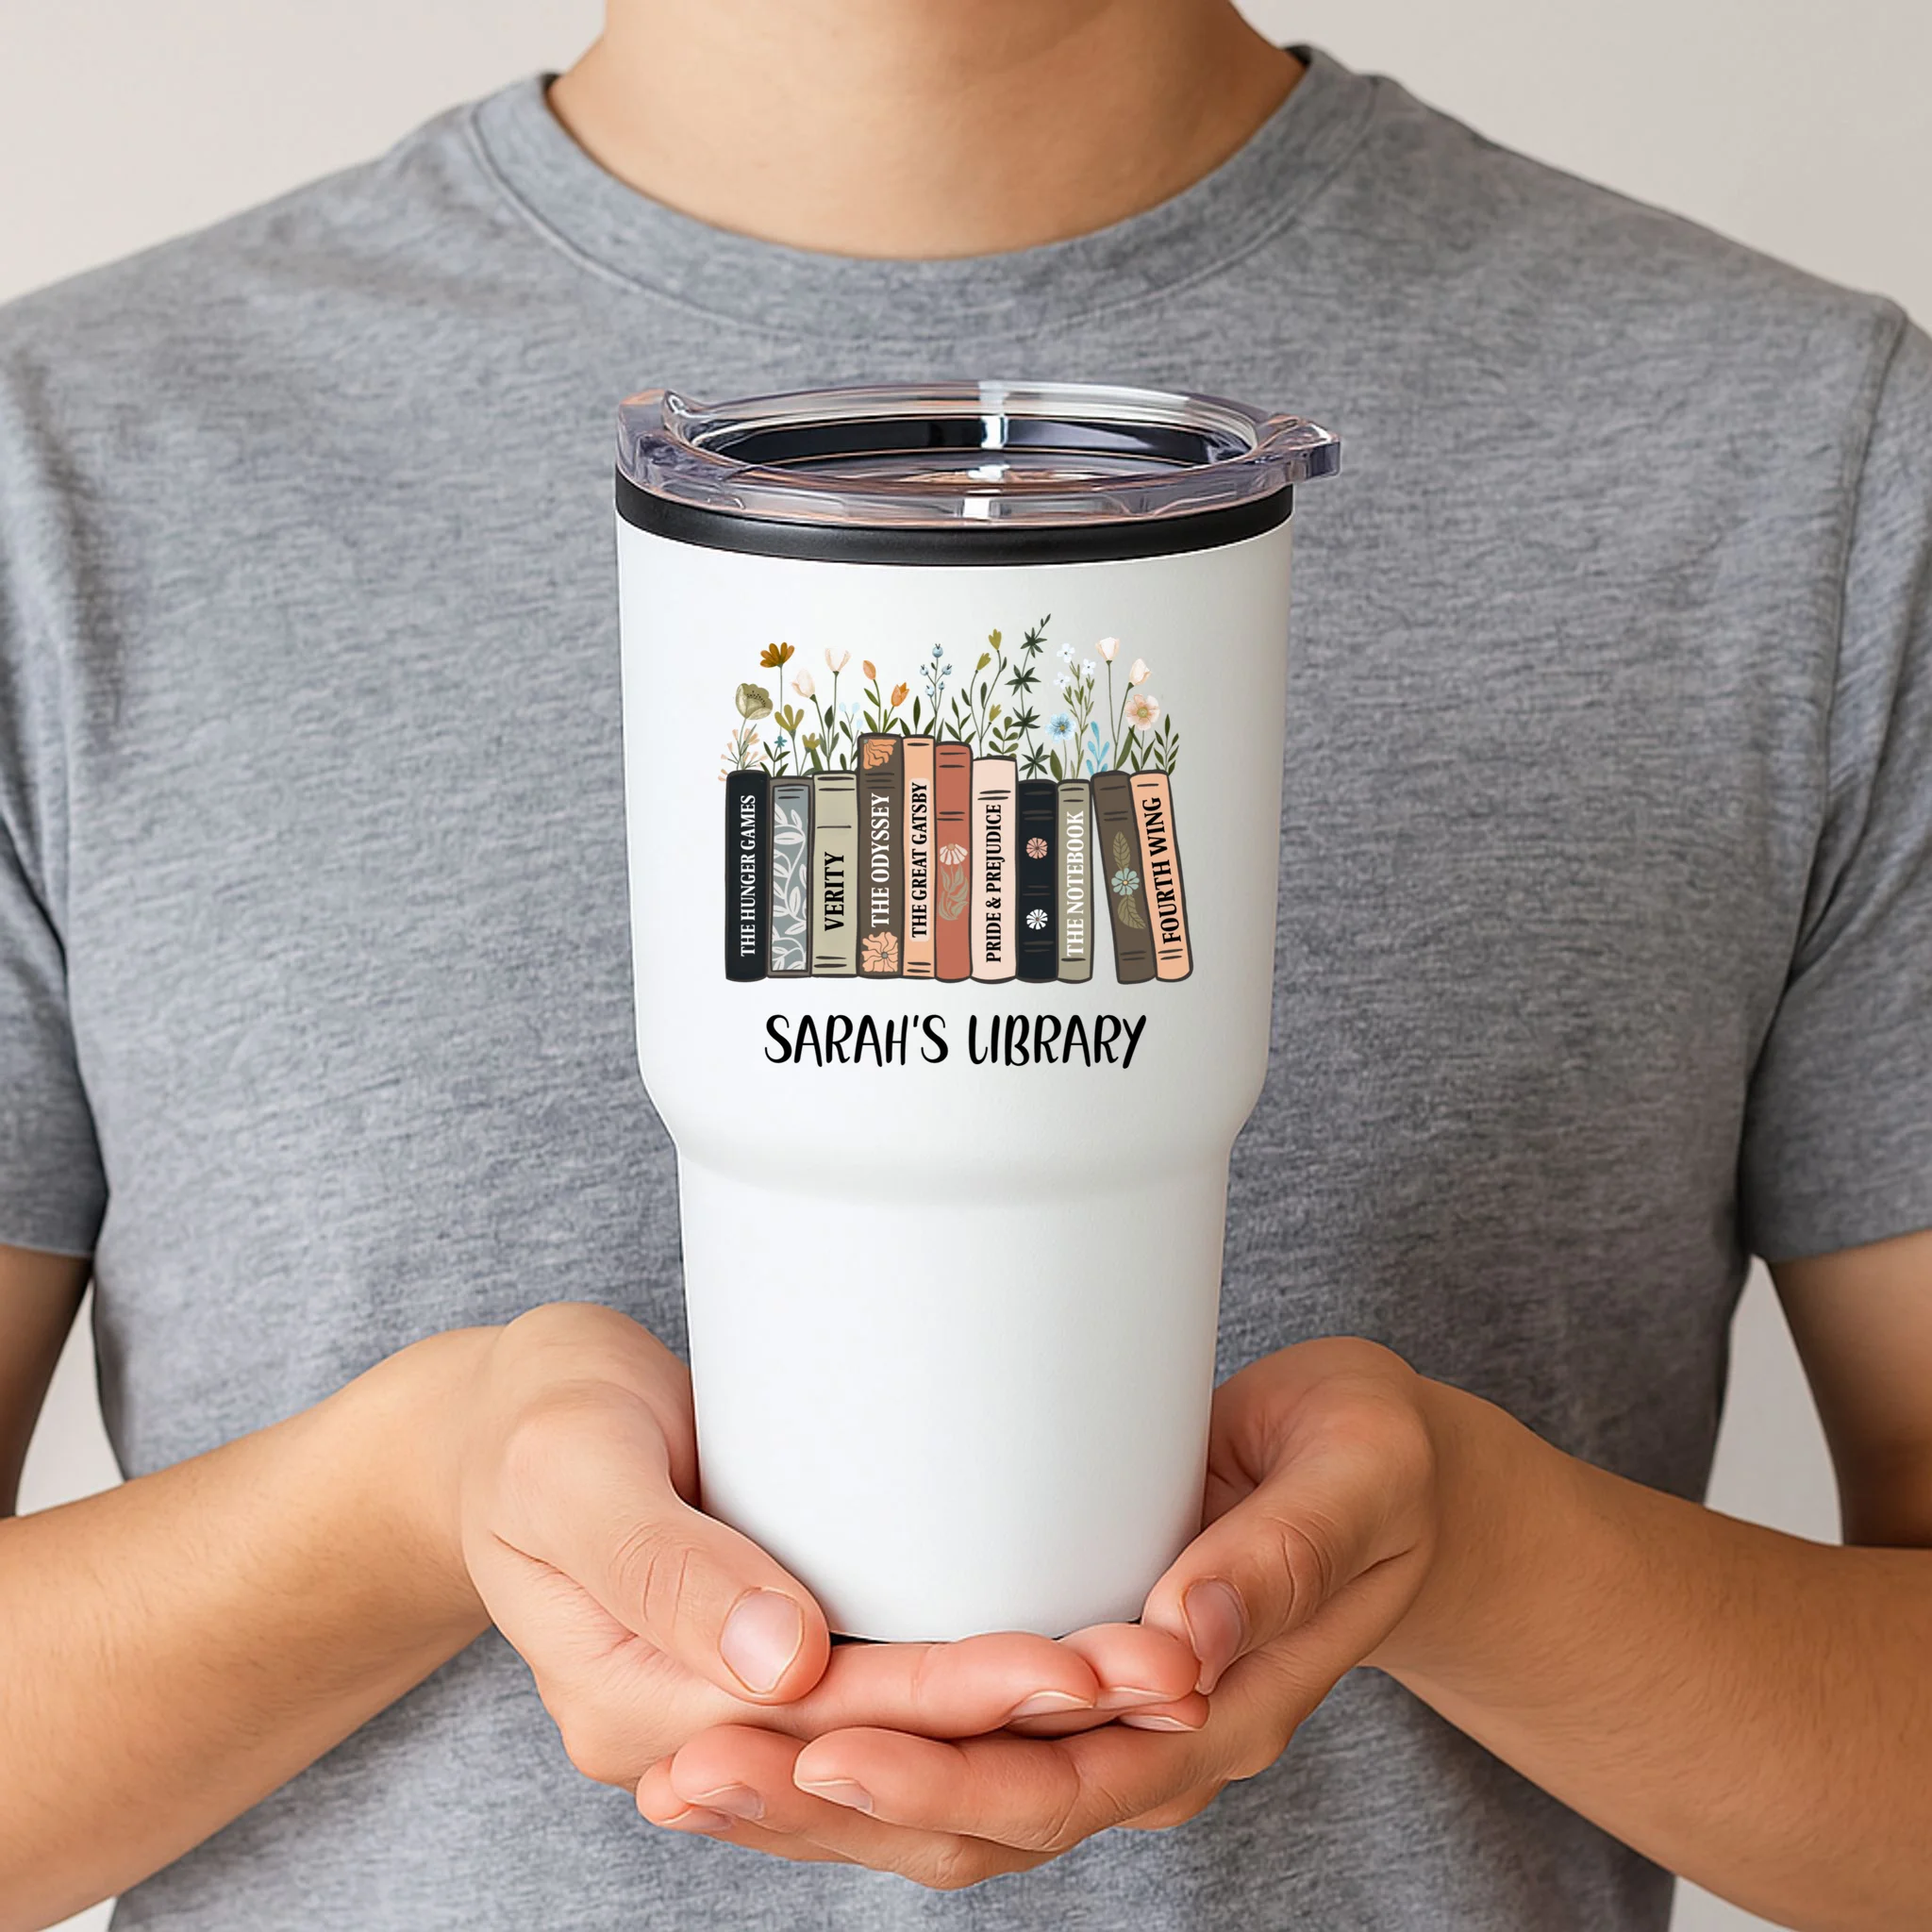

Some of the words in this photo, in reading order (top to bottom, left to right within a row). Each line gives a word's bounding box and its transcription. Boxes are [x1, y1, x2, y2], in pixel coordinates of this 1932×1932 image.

[740, 794, 756, 851] GAMES
[871, 792, 890, 883] ODYSSEY
[911, 782, 927, 845] GATSBY
[1142, 797, 1166, 857] WING
[911, 849, 927, 901] GREAT
[986, 804, 1006, 893] PREJUDICE
[1066, 810, 1084, 915] NOTEBOOK
[740, 854, 756, 921] HUNGER
[824, 852, 844, 931] VERITY
[871, 887, 890, 928] THE
[986, 897, 1002, 909] &
[1152, 859, 1181, 945] FOURTH
[740, 924, 756, 957] THE
[911, 905, 927, 938] THE
[986, 913, 1002, 963] PRIDE
[1066, 919, 1084, 957] THE
[764, 1013, 948, 1067] SARAH'S
[968, 1014, 1147, 1069] LIBRARY
